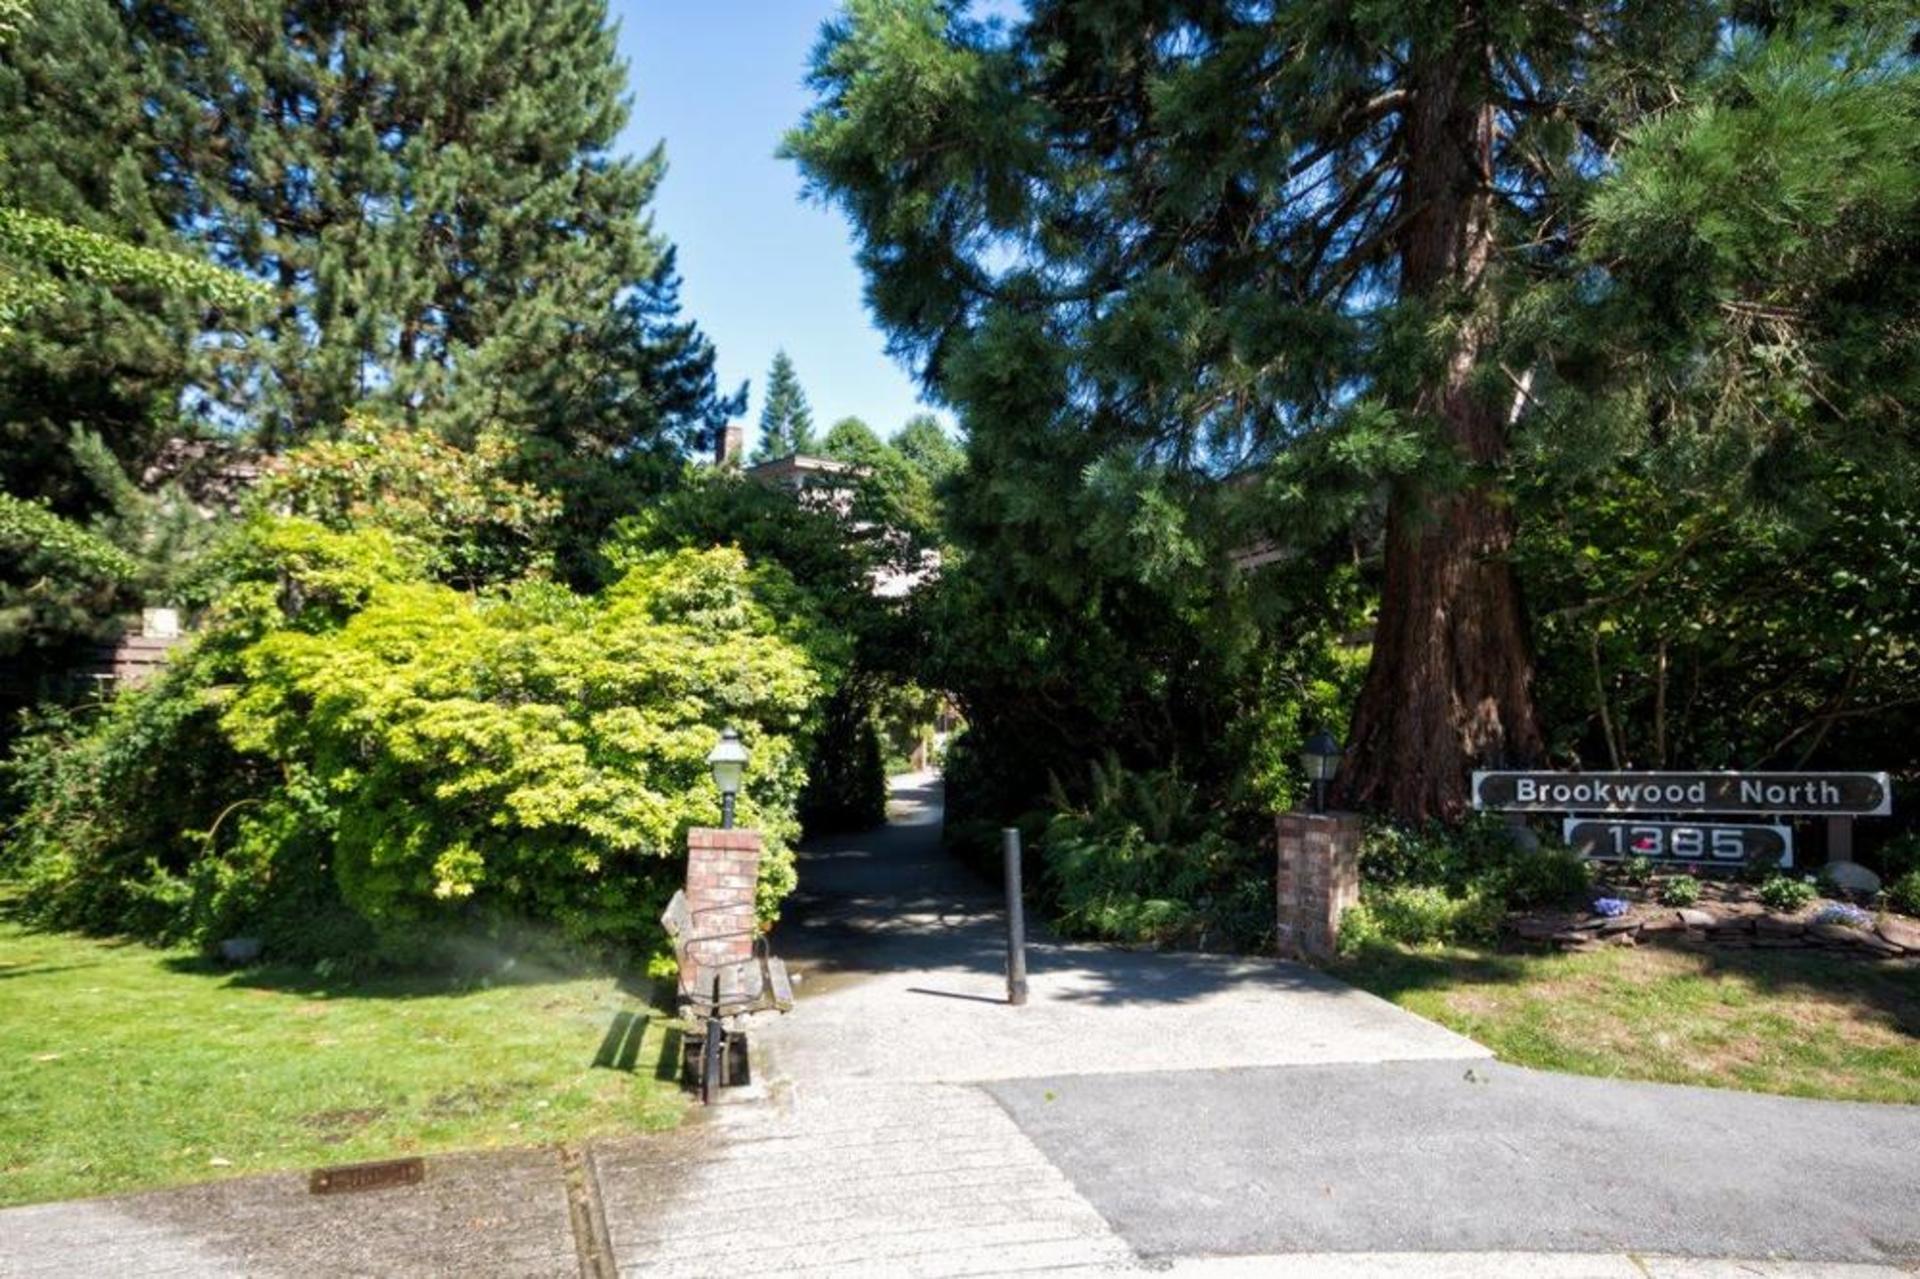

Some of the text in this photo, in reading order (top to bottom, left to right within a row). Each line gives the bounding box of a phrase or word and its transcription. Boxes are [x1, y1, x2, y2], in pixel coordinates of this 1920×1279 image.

[1516, 778, 1840, 805] Brookwood North
[1608, 825, 1745, 859] 1385
